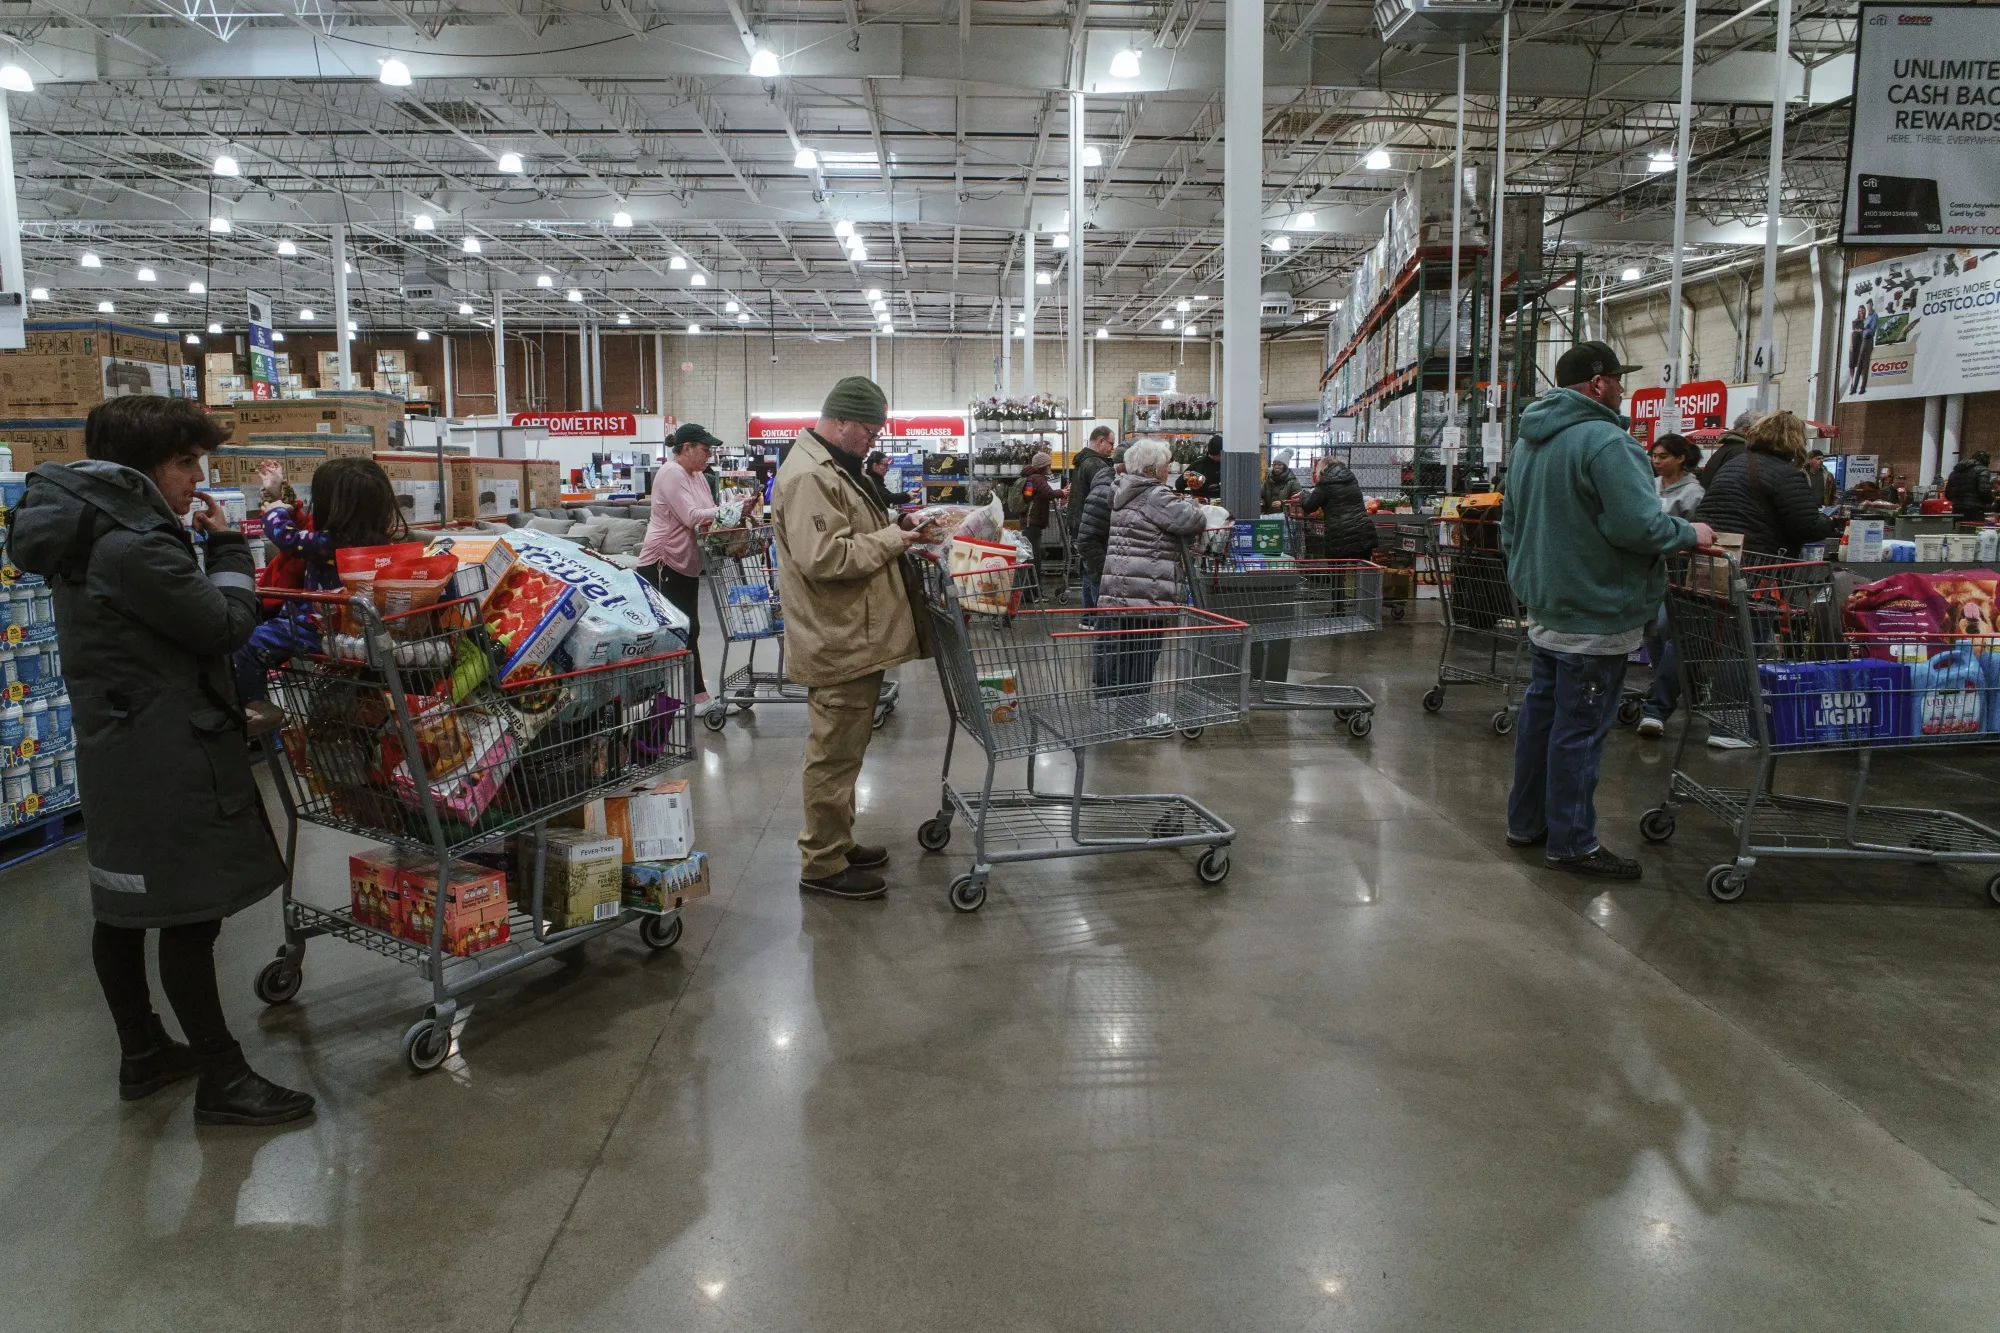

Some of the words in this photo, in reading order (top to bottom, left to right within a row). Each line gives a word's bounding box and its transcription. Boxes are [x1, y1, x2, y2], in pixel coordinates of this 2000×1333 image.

[1894, 59, 2000, 80] UNLIMITE
[1887, 84, 1949, 105] CASH
[1956, 86, 2000, 106] BAC
[1895, 110, 2000, 131] REWARDS
[1947, 136, 2000, 145] EVERYWHER
[1947, 226, 1978, 234] APPLY
[1981, 227, 2000, 235] TOD
[1926, 287, 1960, 301] THERE'S
[1963, 281, 1990, 294] MORE
[1754, 347, 1764, 368] 4
[1663, 364, 1671, 383] 3
[1872, 361, 1908, 372] COSTCO
[1636, 392, 1720, 419] MEMRSHIP
[520, 416, 627, 431] OPTOMETRIST
[905, 428, 952, 436] SUNGLASSES
[28, 627, 55, 636] COLLAGEN
[528, 616, 563, 658] PEPPERONI
[536, 637, 557, 658] PIZZA
[621, 640, 655, 655] Towel
[31, 682, 58, 692] COLLAGEN
[1821, 692, 1866, 709] BUD
[1815, 708, 1872, 726] LIGHT
[41, 736, 67, 748] COLLAGEN
[45, 789, 71, 801] COLLAGEN
[580, 845, 615, 856] FEVER-TREE
